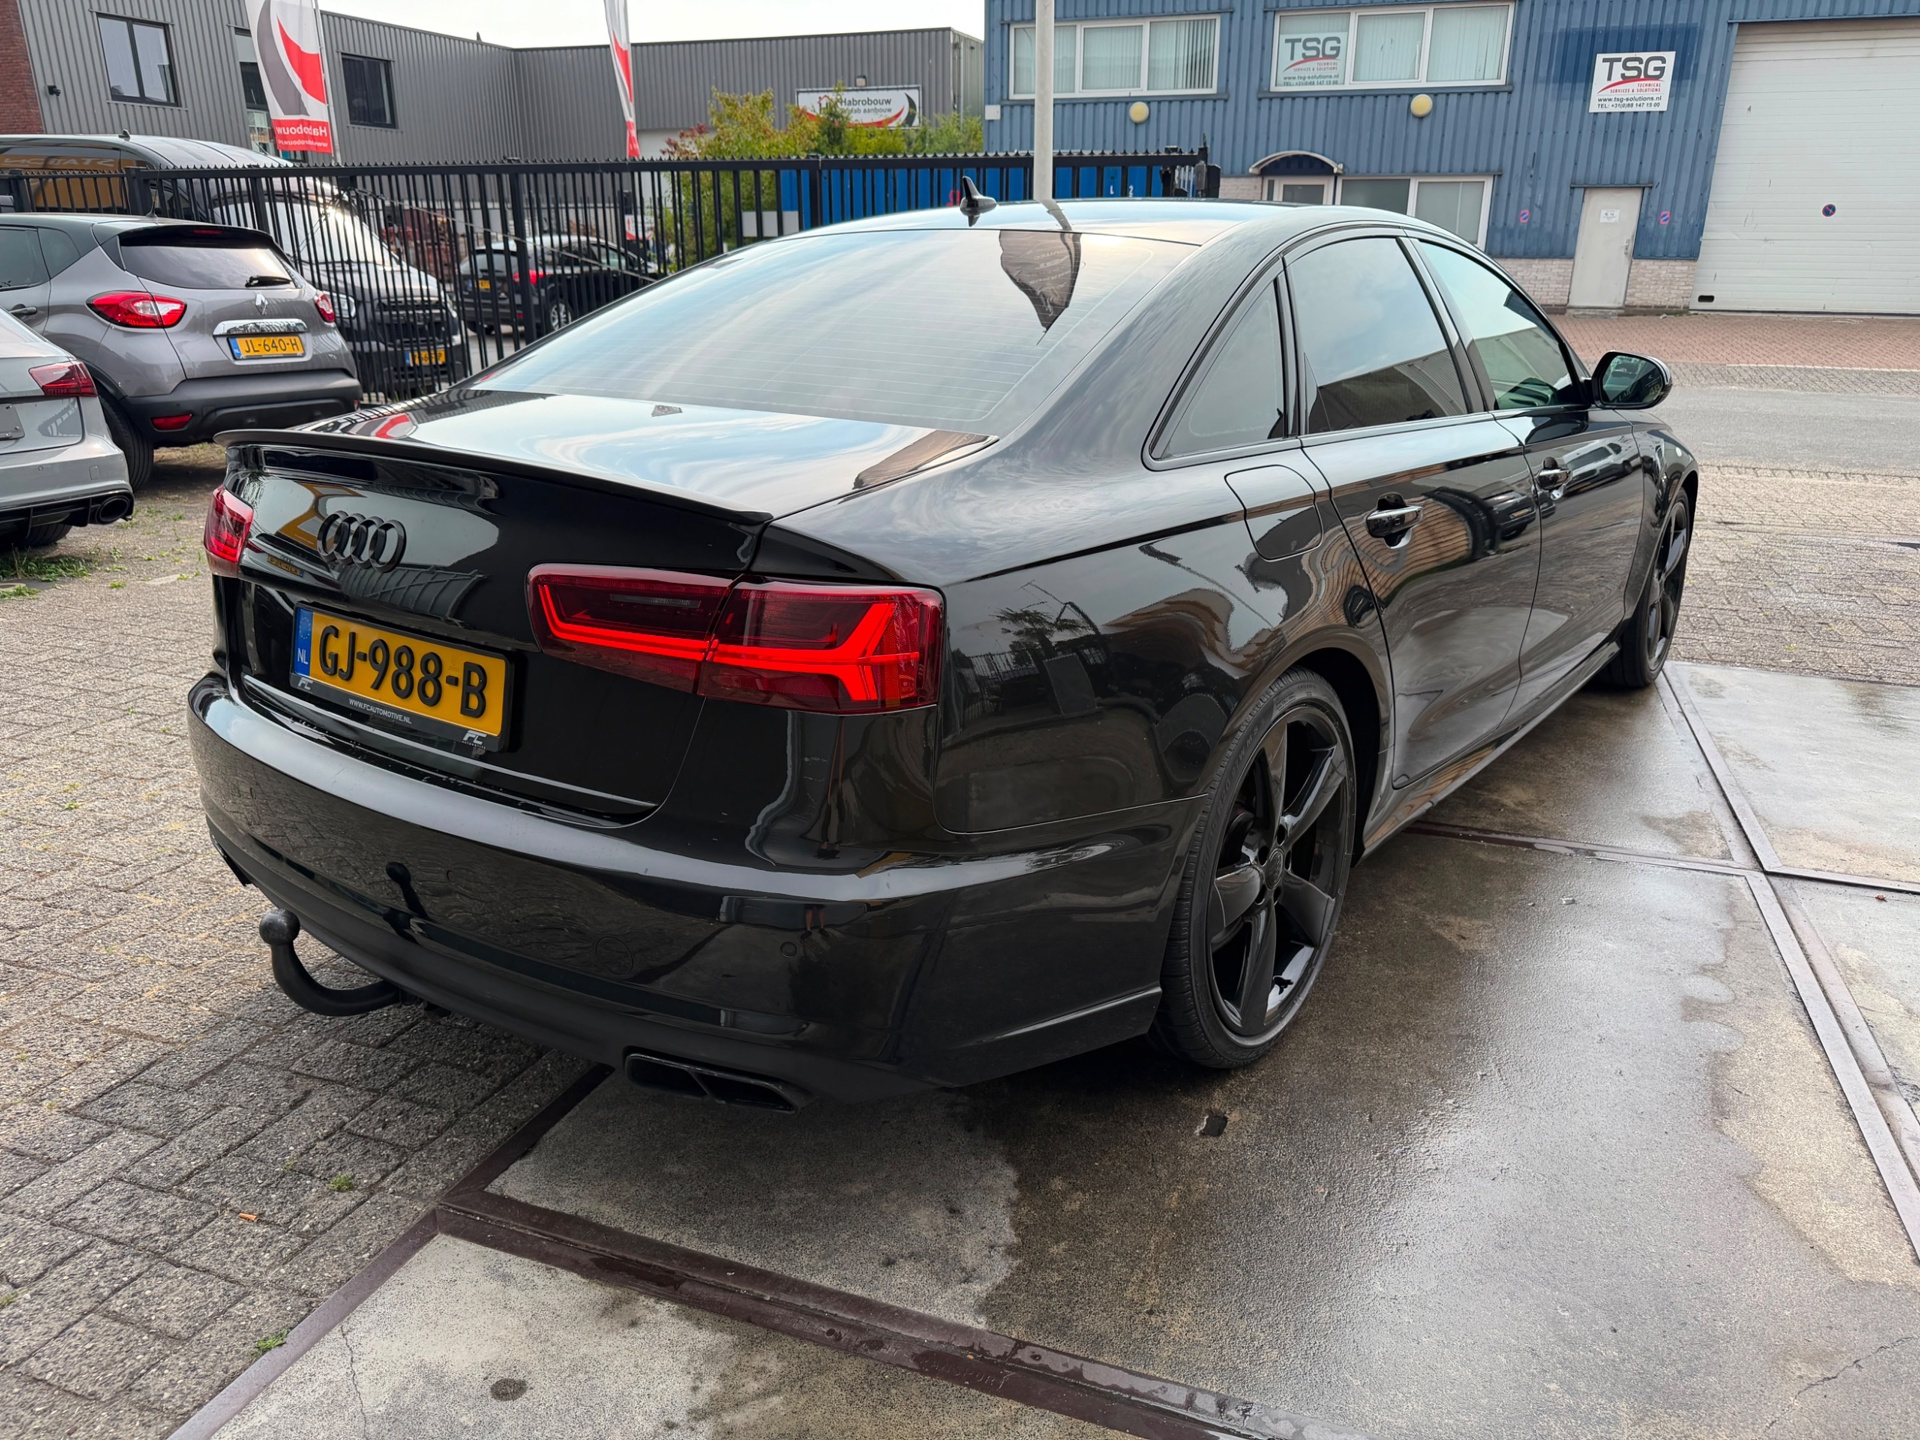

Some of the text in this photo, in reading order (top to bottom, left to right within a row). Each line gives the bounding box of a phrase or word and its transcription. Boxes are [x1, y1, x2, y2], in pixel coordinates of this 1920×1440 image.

[1284, 36, 1342, 61] TSG
[1601, 55, 1667, 82] TSG
[840, 97, 892, 107] Habrobouw
[1597, 95, 1662, 103] www.tsg-solutions.nl
[245, 338, 300, 353] JL-640-H
[297, 647, 309, 666] NL
[319, 624, 488, 719] GJ-988-B
[348, 698, 412, 725] WWW.FCAUTOMOTIVE.NL
[462, 729, 488, 746] FC
